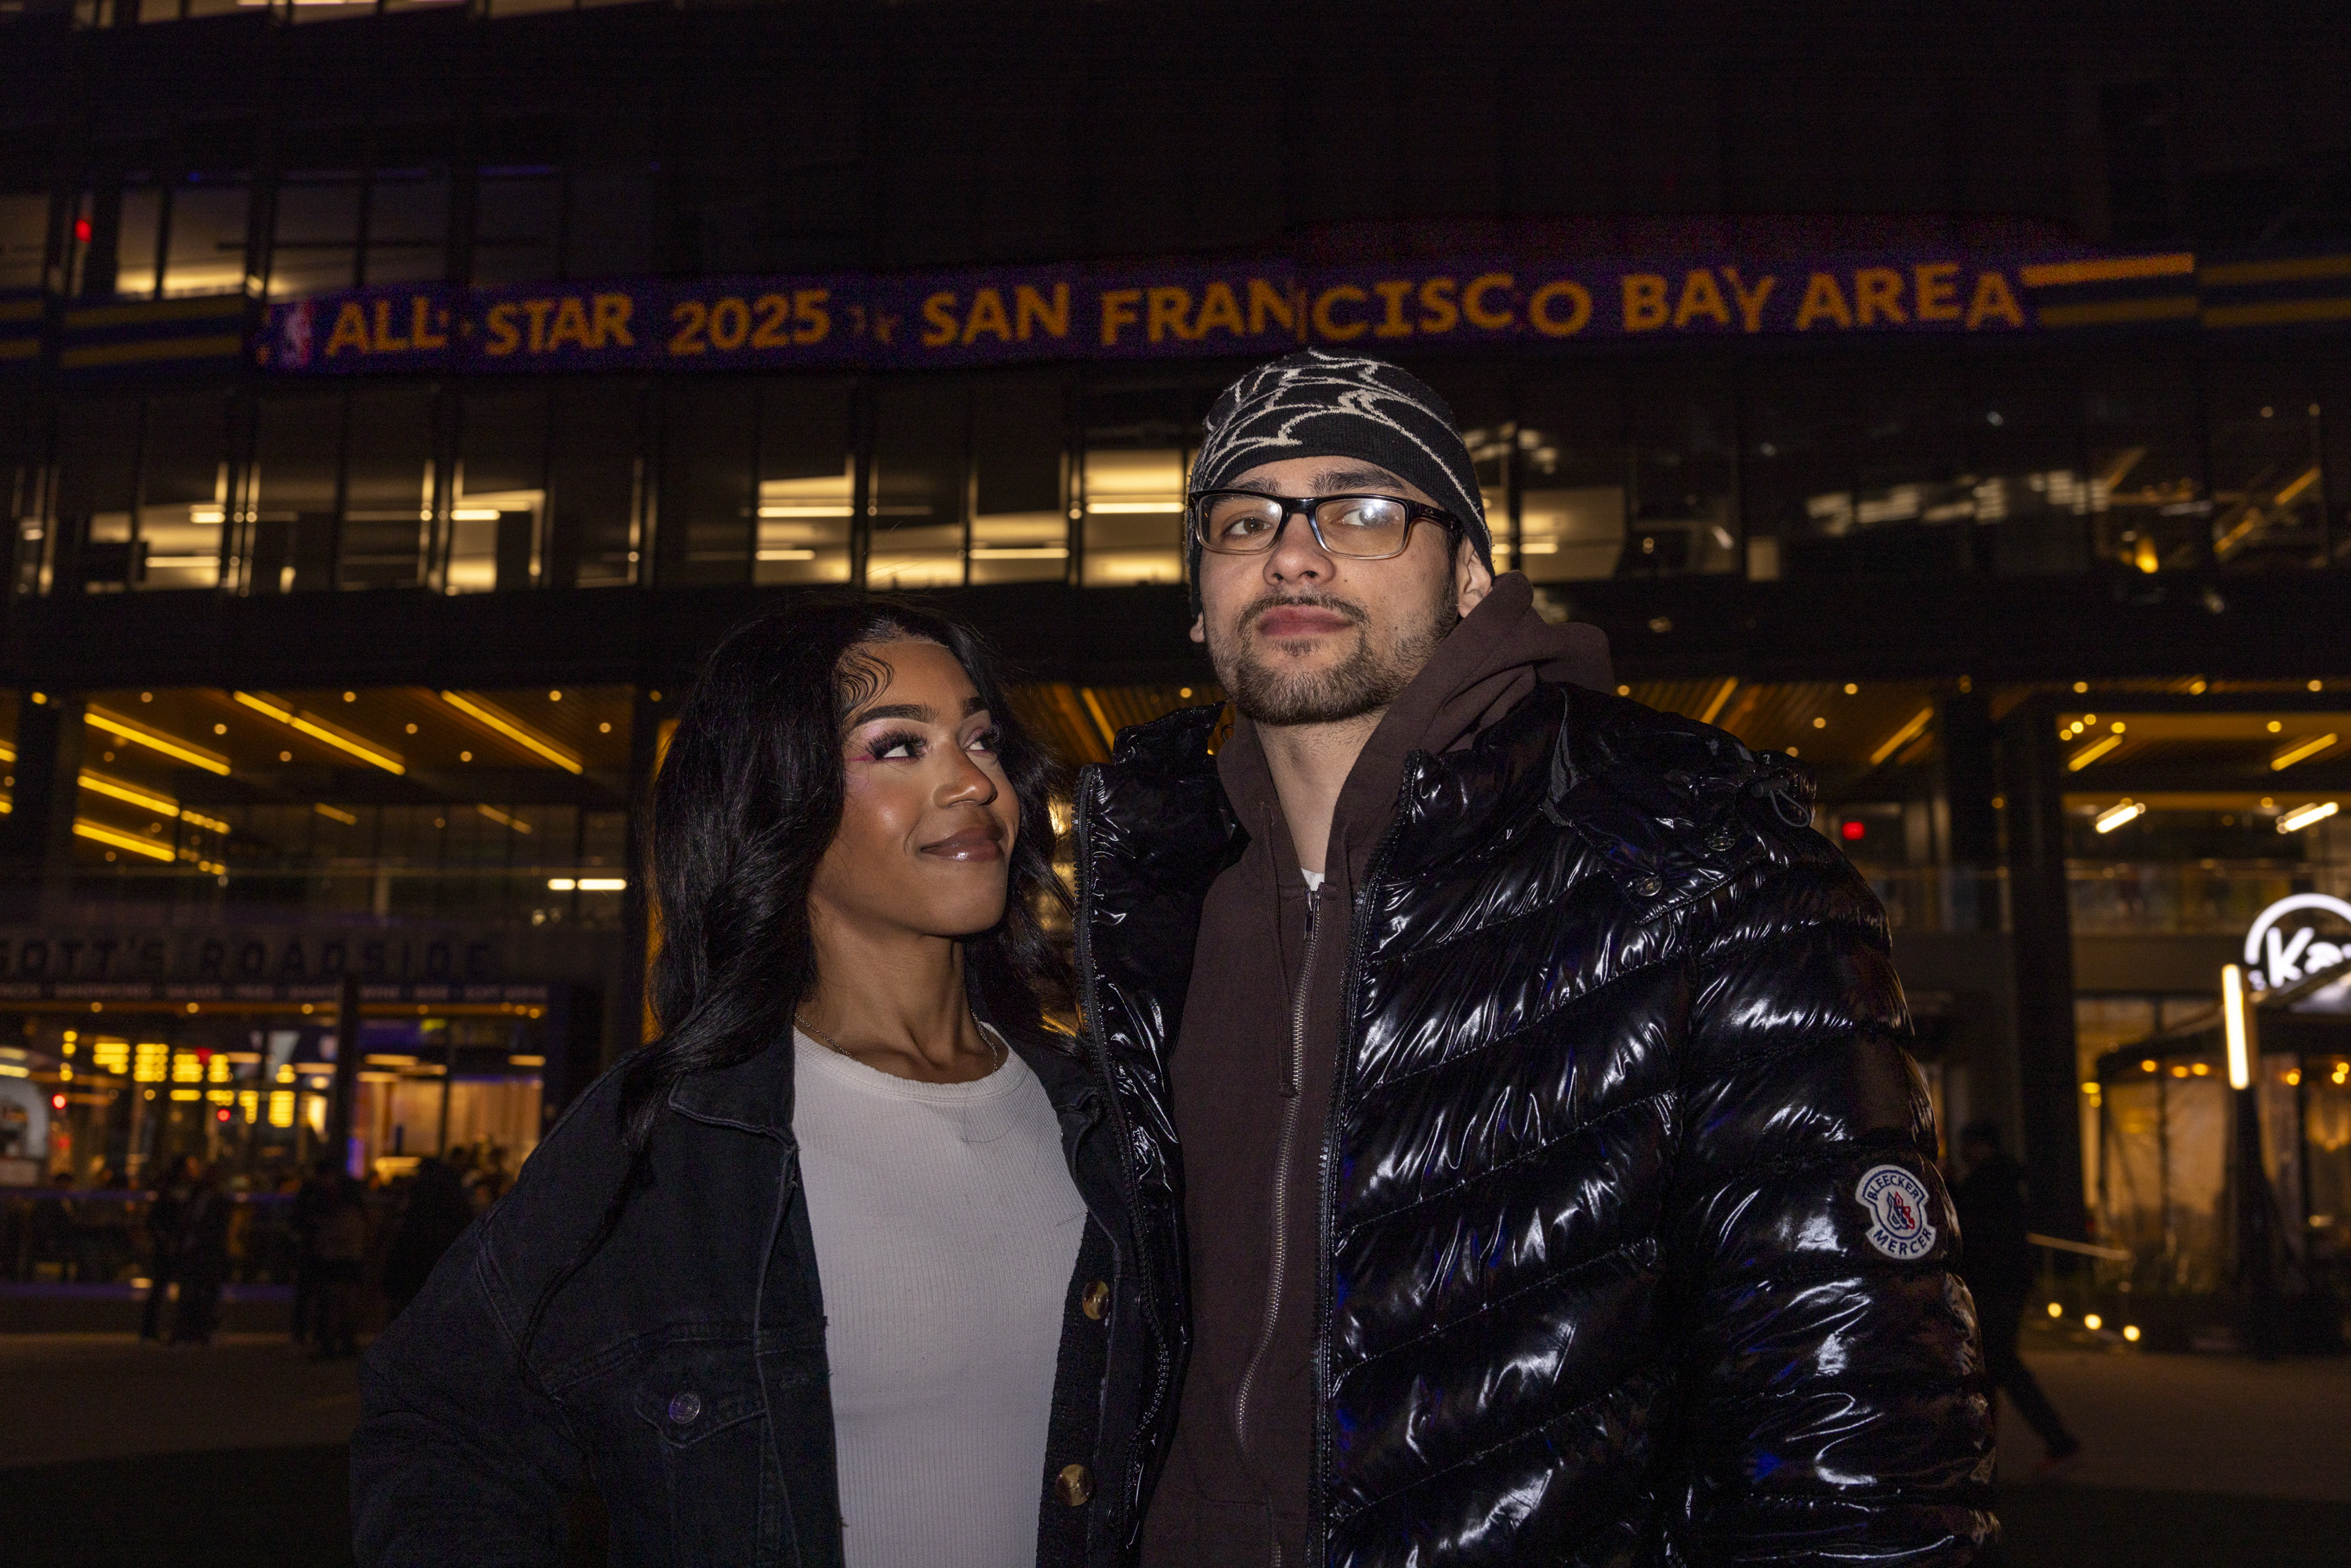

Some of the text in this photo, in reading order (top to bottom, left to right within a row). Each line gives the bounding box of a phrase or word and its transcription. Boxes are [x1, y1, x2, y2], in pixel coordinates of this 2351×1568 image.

[668, 288, 831, 357] 2025
[921, 283, 1070, 346] SAN
[1099, 273, 1592, 346] FRANCISCO
[1621, 269, 1776, 332] BAY
[1795, 263, 2024, 331] AREA
[201, 940, 487, 976] ROADSIDE
[1867, 1175, 1919, 1200] BLEECKER
[1874, 1228, 1932, 1255] MERCER
